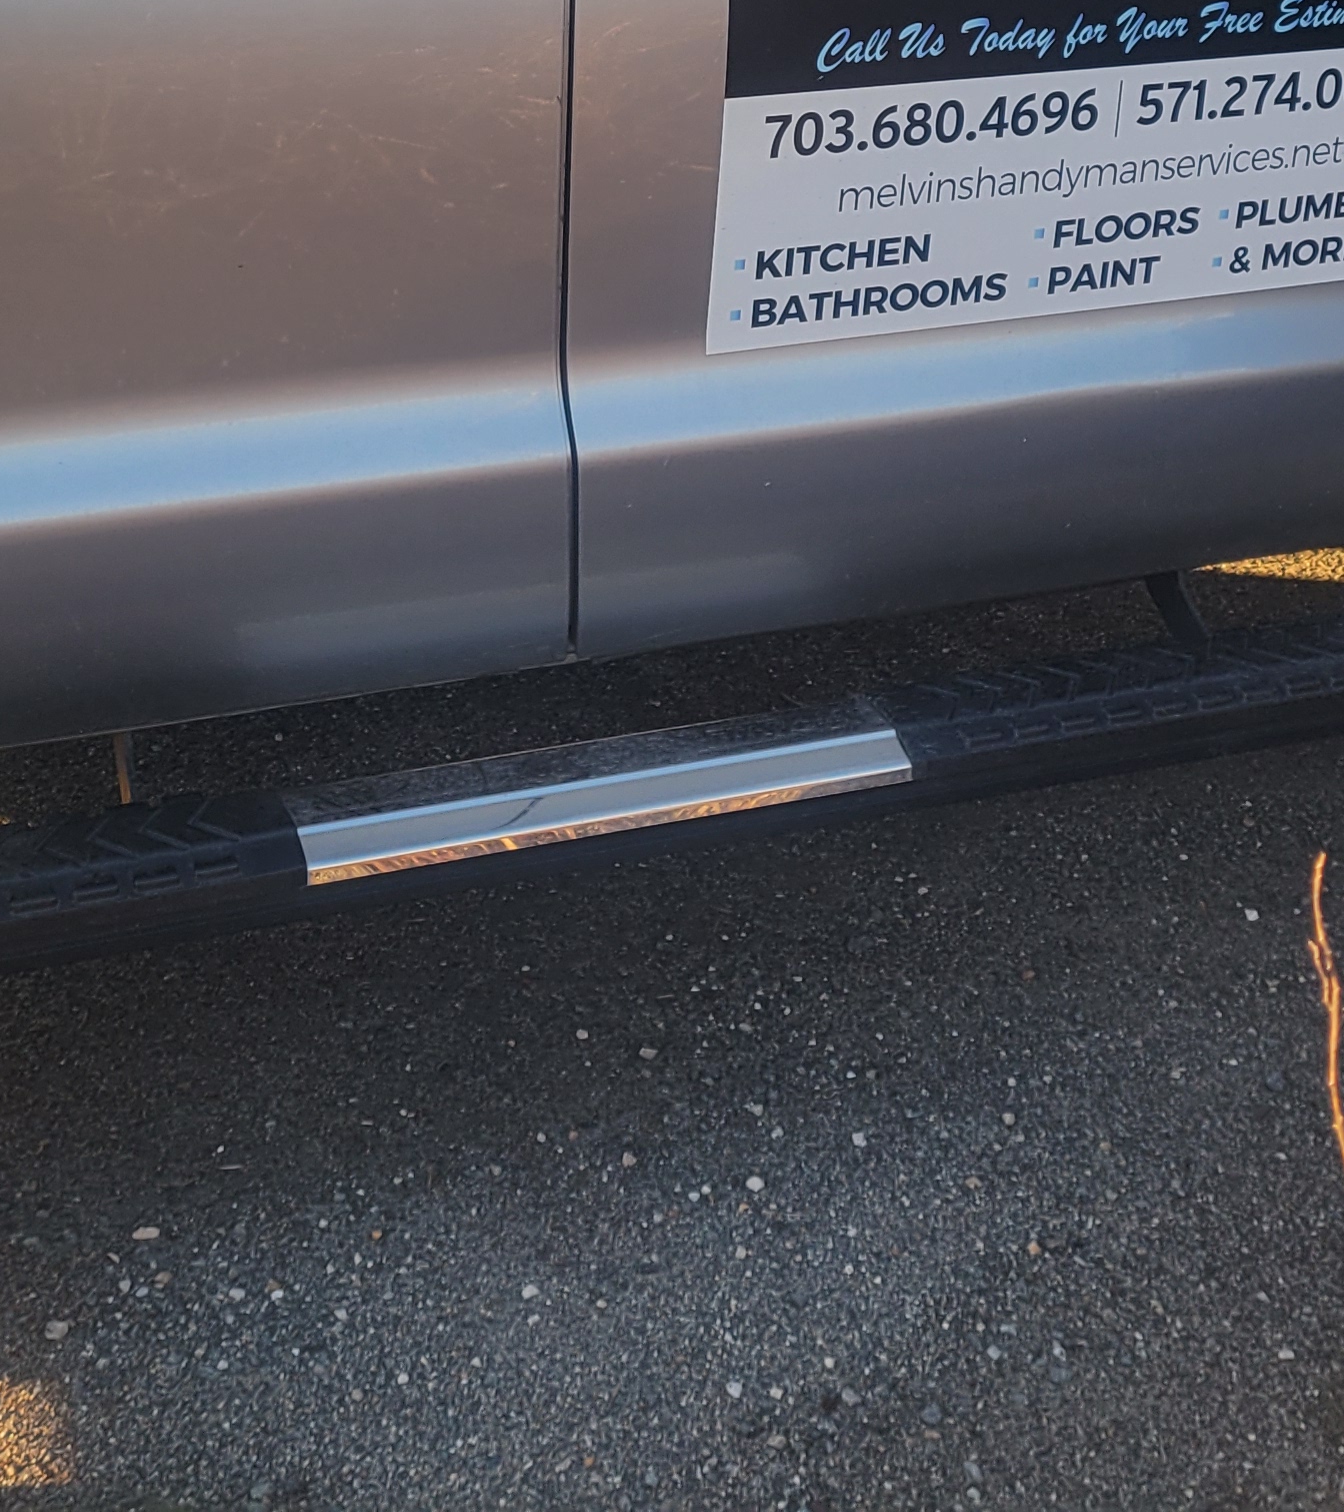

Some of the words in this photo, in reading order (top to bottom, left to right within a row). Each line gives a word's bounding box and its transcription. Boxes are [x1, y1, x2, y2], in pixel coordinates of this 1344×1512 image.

[816, 27, 891, 73] Call
[898, 22, 946, 60] Us
[960, 17, 1057, 59] Today
[1062, 12, 1109, 59] for
[1115, 6, 1189, 54] Your
[1198, 0, 1265, 44] Free
[764, 88, 1099, 159] 703.680.4696
[837, 136, 1344, 213] melvinshandymanservices.net
[1052, 206, 1201, 250] FLOORS
[754, 233, 932, 280] KITCHEN
[1046, 256, 1162, 295] PAINT
[1228, 245, 1252, 276] &
[750, 273, 1008, 329] BATHROOMS
